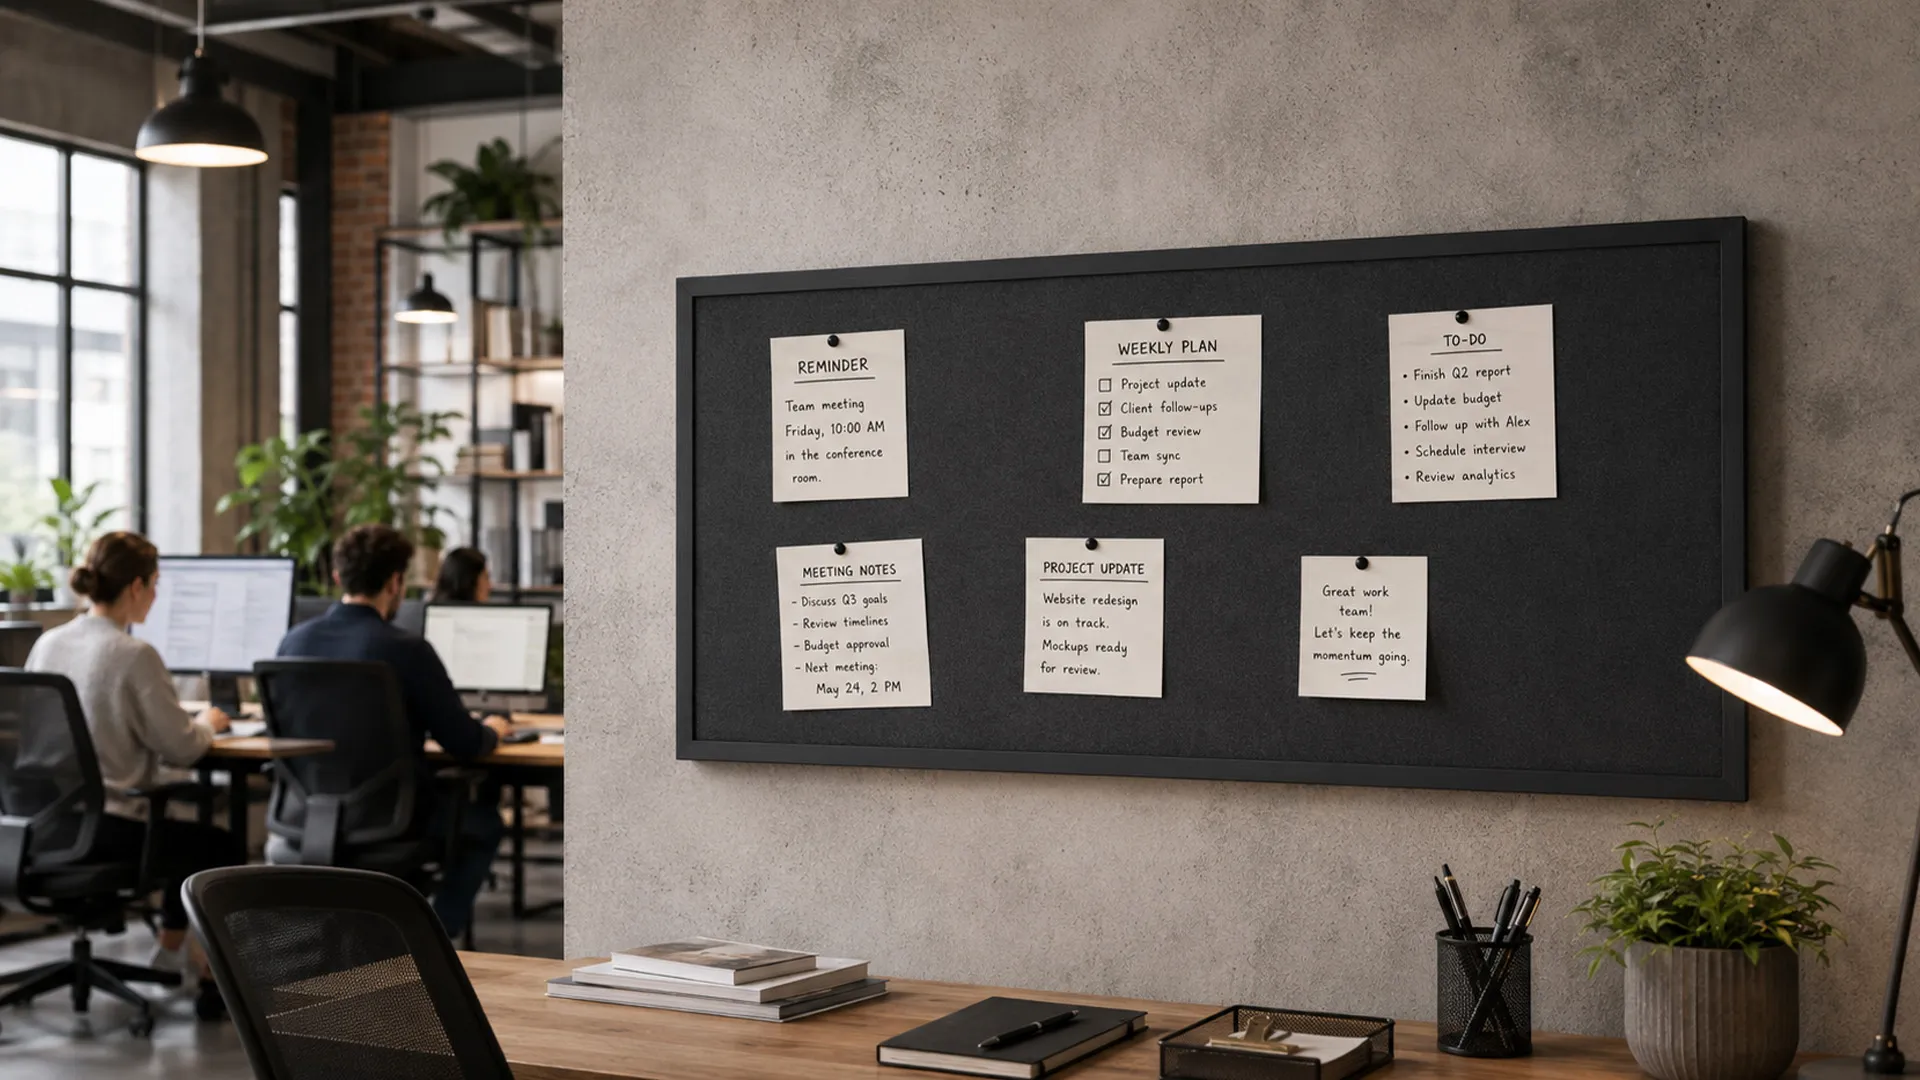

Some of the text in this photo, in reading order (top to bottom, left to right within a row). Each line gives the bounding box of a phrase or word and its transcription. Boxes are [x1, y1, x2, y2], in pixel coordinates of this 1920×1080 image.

[1117, 339, 1218, 356] WEEKLY PLAN
[1442, 332, 1487, 347] TO-DO
[797, 356, 869, 375] REMINDER
[1413, 364, 1511, 382] Finish Q2 report
[1121, 375, 1207, 395] Project update
[784, 398, 865, 414] Team meeting
[1120, 399, 1218, 417] Client follow-ups
[1414, 391, 1503, 411] Update budget
[785, 420, 886, 441] Friday, 10:00 AM
[1120, 425, 1202, 443] Budget review
[1414, 415, 1531, 435] Follow up with Alex
[785, 445, 884, 461] in the conference
[1119, 448, 1181, 466] Team sync
[1415, 442, 1526, 458] Schedule interview
[792, 475, 822, 484] room.
[1120, 472, 1204, 490] Prepare report
[1415, 468, 1516, 486] Review analytics
[802, 563, 897, 579] MEETING NOTES
[1043, 560, 1145, 576] PROJECT UPDATE
[1322, 584, 1390, 598] Great work
[801, 592, 889, 609] Discuss Q3 goals
[1042, 592, 1139, 611] Website redesign
[1338, 603, 1373, 617] team!
[802, 614, 889, 630] Review timelines
[1042, 616, 1110, 629] is on track.
[1314, 626, 1401, 644] Let's keep the
[803, 636, 890, 655] Budget approval
[1041, 638, 1128, 658] Mockups ready
[1312, 649, 1411, 667] momentum going.
[804, 661, 879, 676] Next meeting:
[1039, 660, 1101, 676] for review.
[816, 680, 902, 700] May 24, 2 PM
